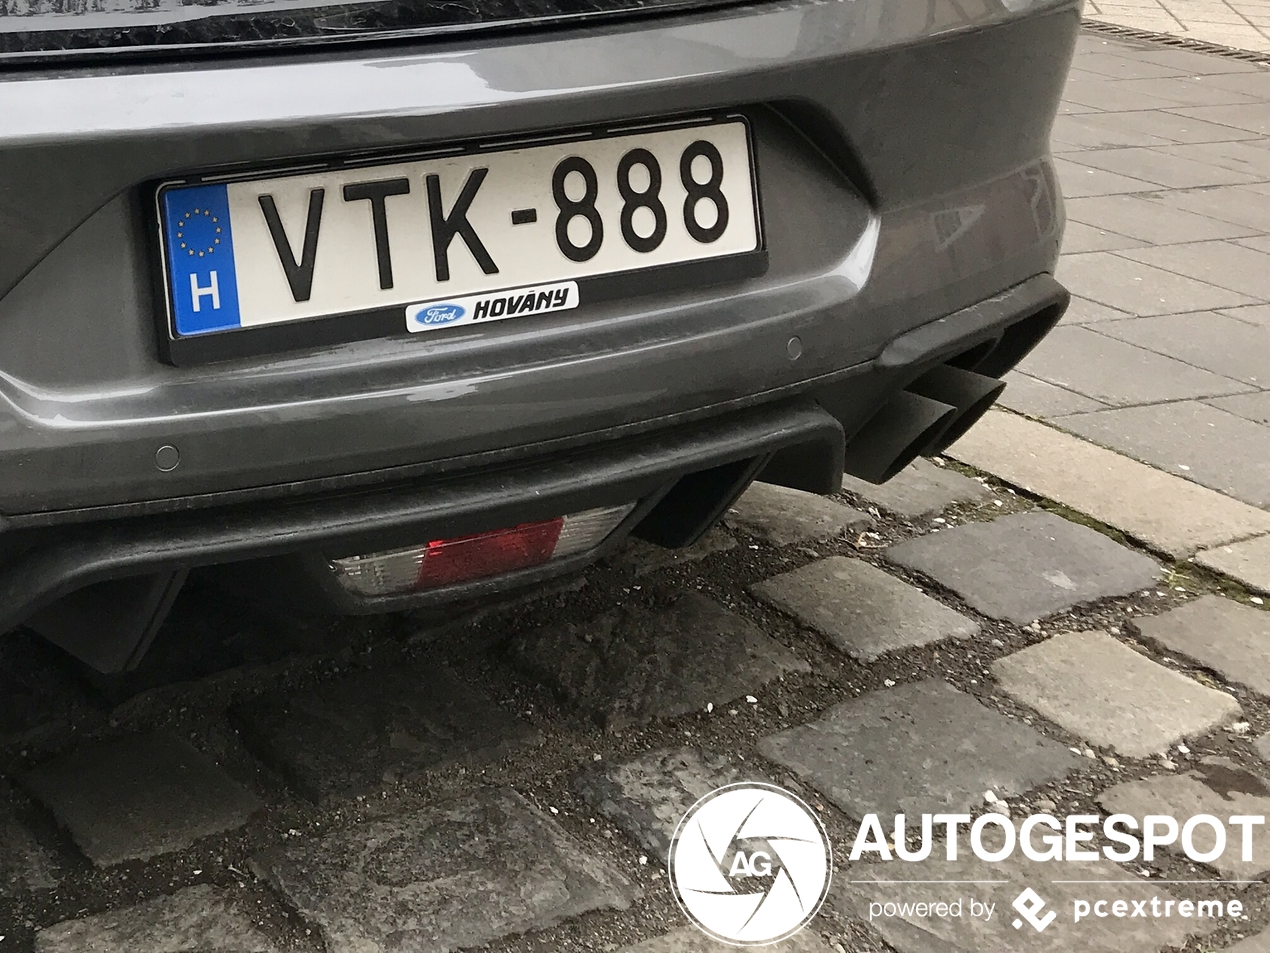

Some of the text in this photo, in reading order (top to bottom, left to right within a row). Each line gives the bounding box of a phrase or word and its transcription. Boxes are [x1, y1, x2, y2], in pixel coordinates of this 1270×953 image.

[258, 140, 729, 302] VTK-888
[190, 271, 220, 313] H
[424, 306, 456, 324] Ford
